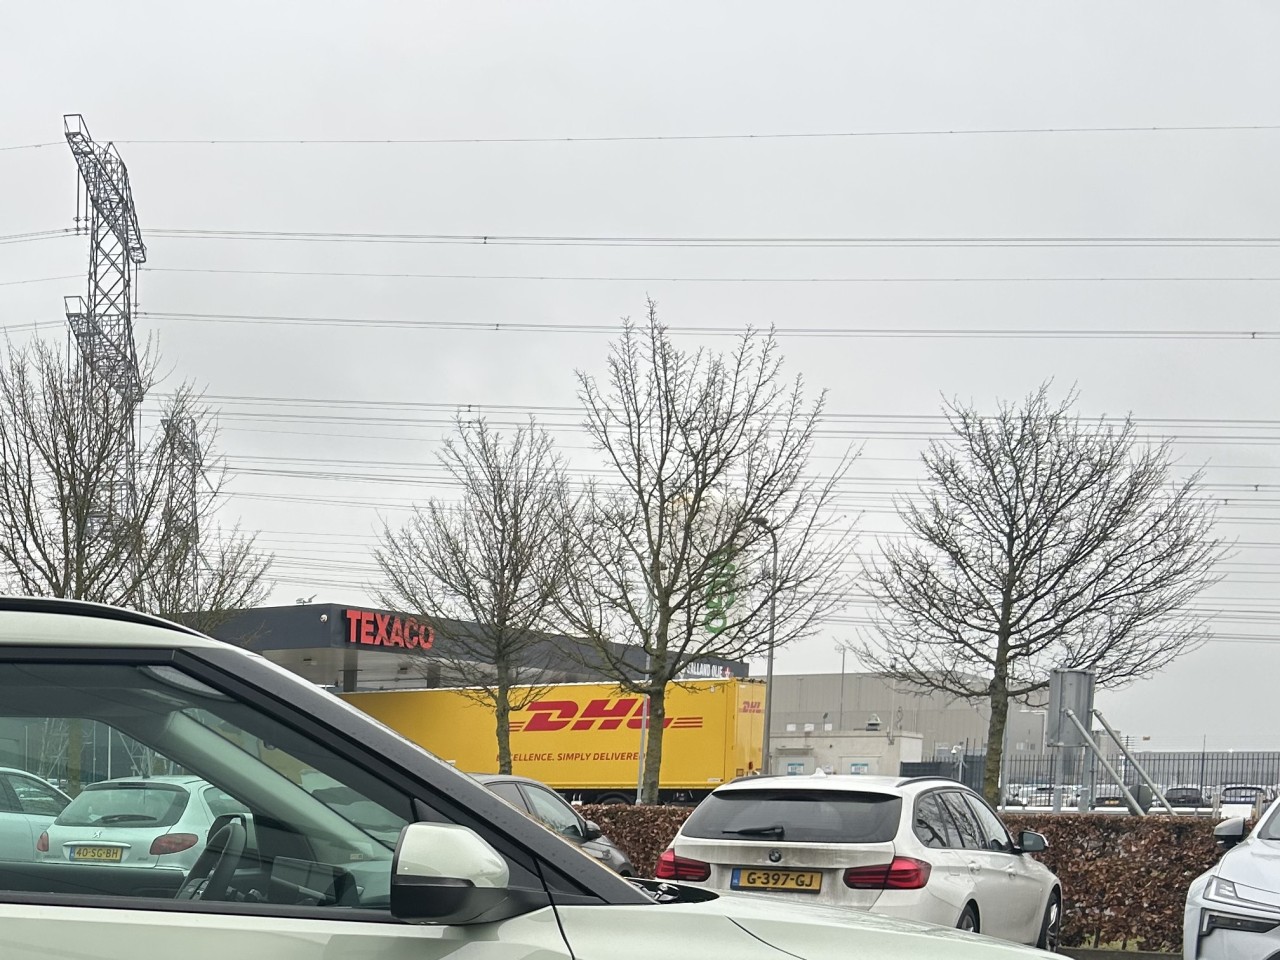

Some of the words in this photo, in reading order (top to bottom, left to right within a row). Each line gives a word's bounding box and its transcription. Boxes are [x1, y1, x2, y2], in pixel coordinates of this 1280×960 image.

[346, 609, 435, 650] TEXACO
[557, 752, 592, 762] SIMPLY
[746, 871, 814, 888] G-397-GJ
